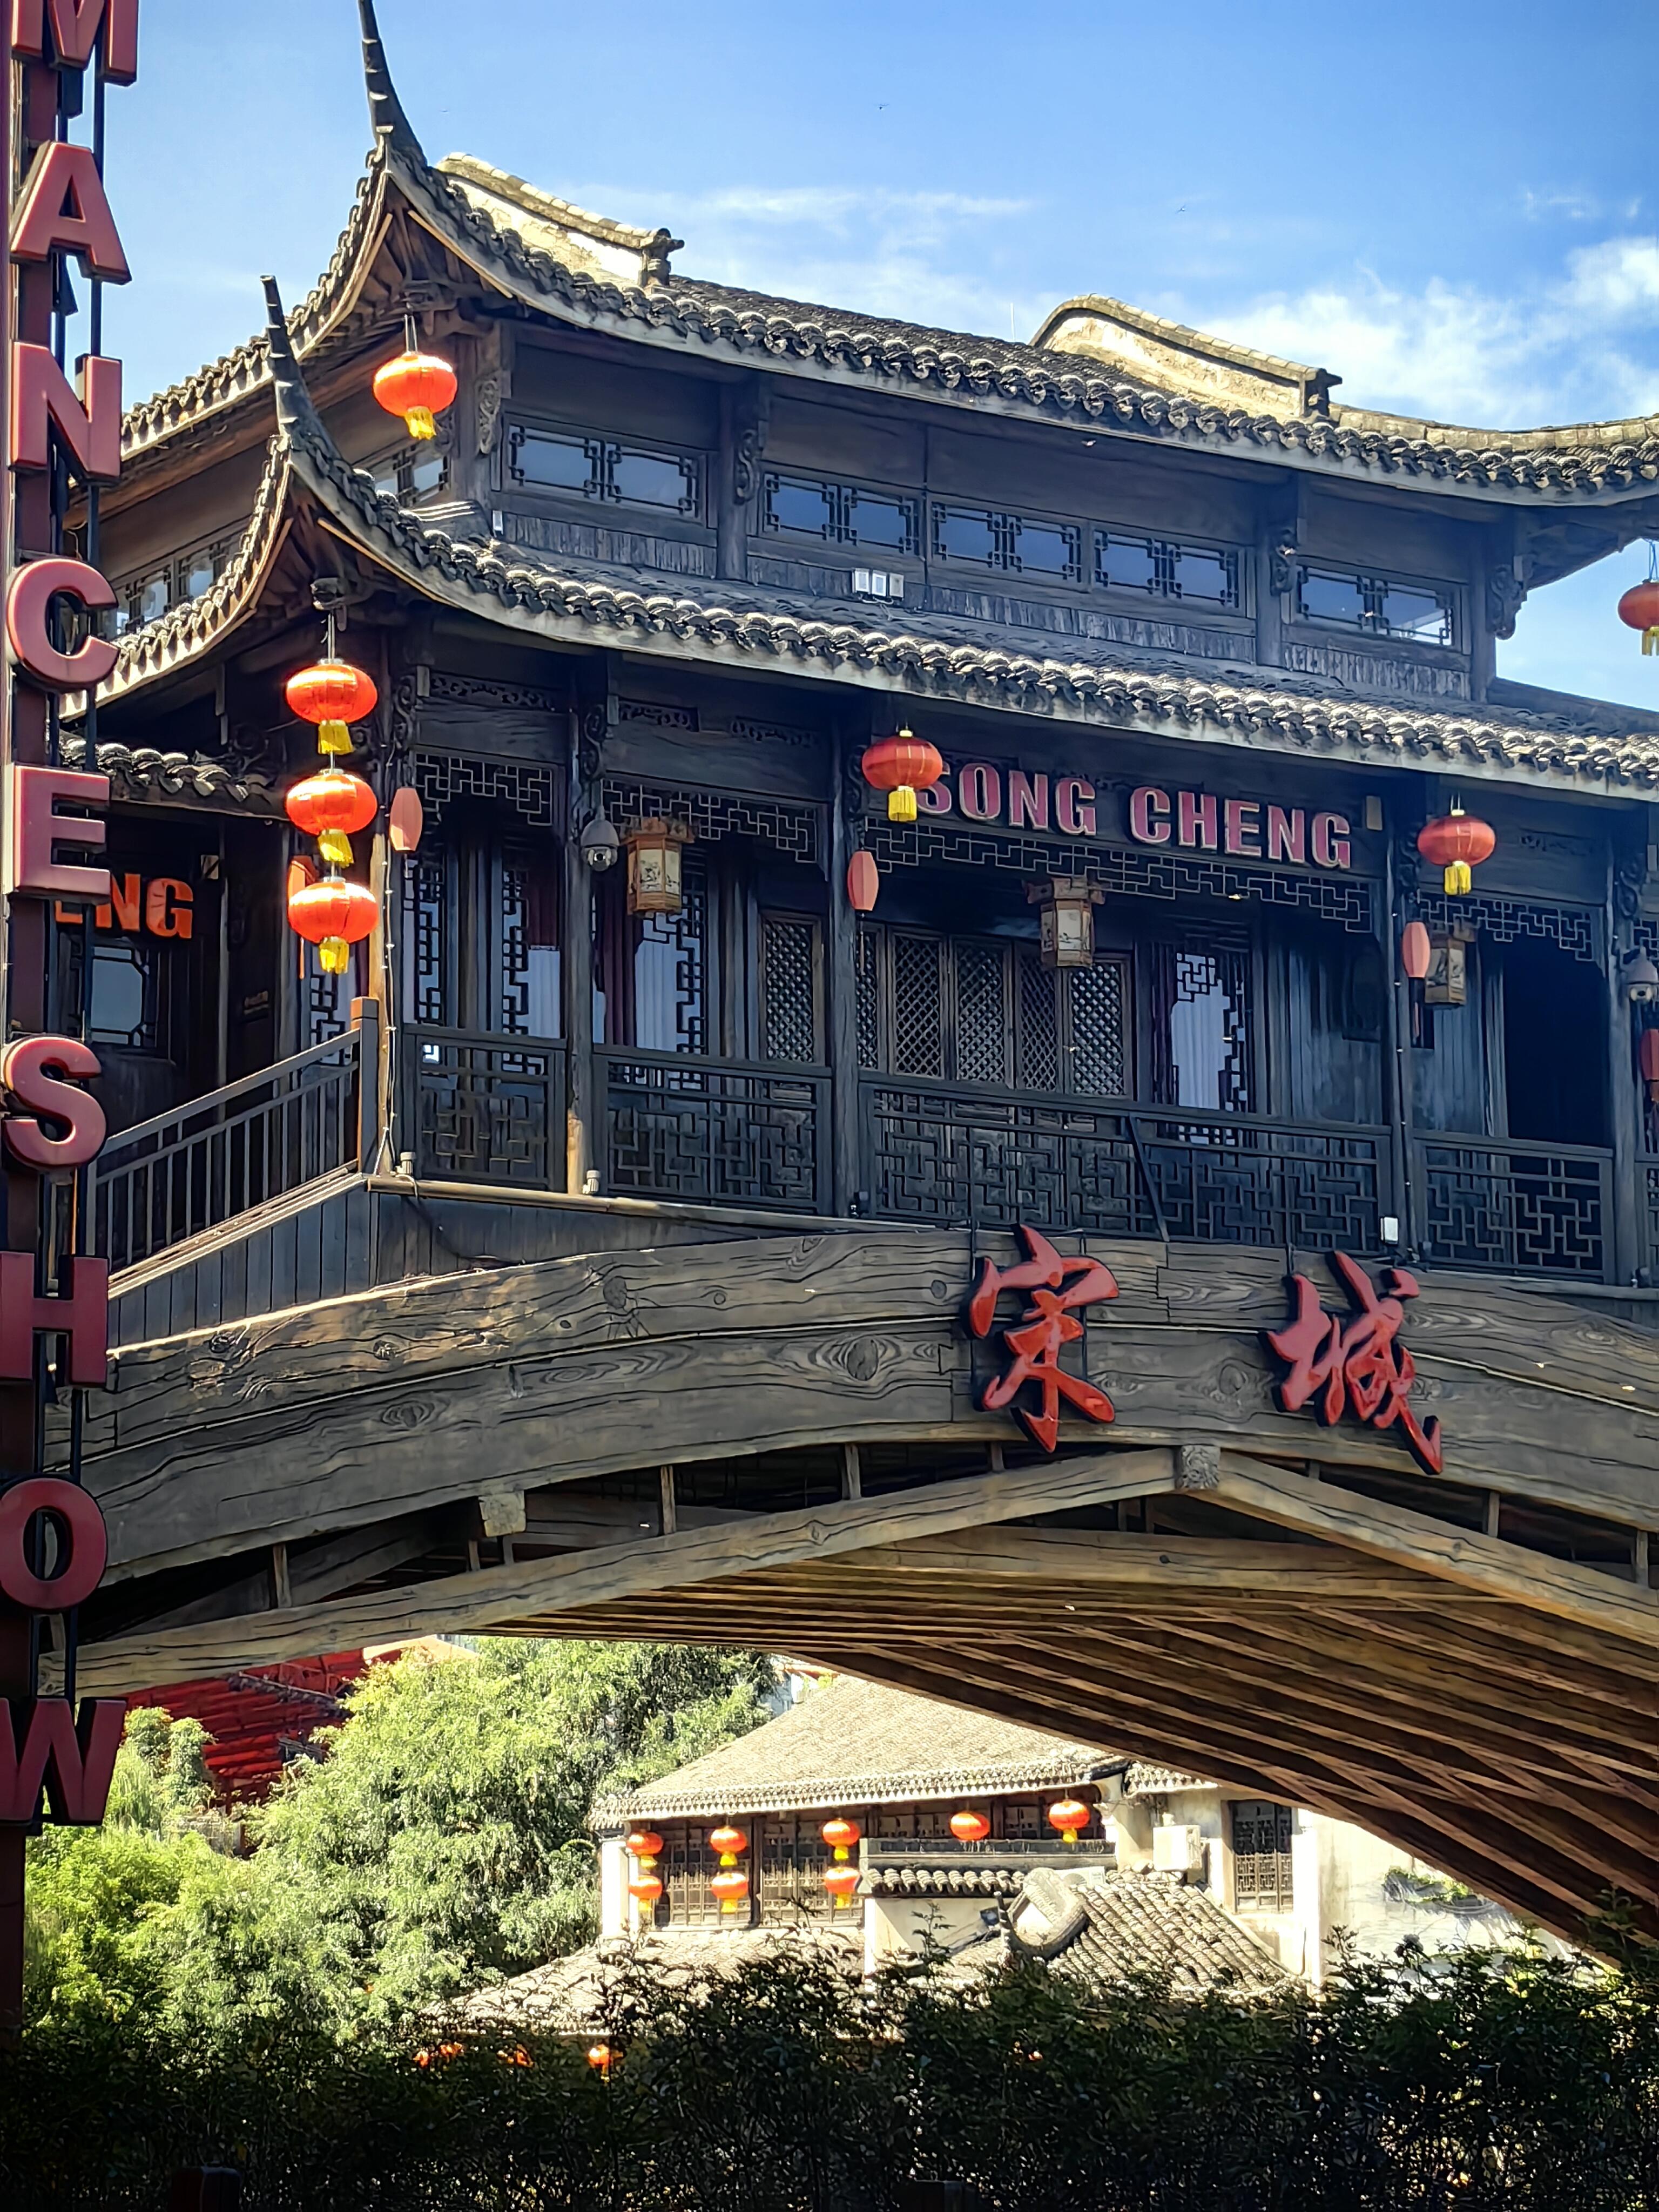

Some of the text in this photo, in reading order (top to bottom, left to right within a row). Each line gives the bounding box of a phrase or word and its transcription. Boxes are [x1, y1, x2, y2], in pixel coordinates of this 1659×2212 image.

[1128, 785, 1352, 870] CHENG
[0, 1035, 127, 1825] SHOW
[970, 1223, 1443, 1474] 宋城
